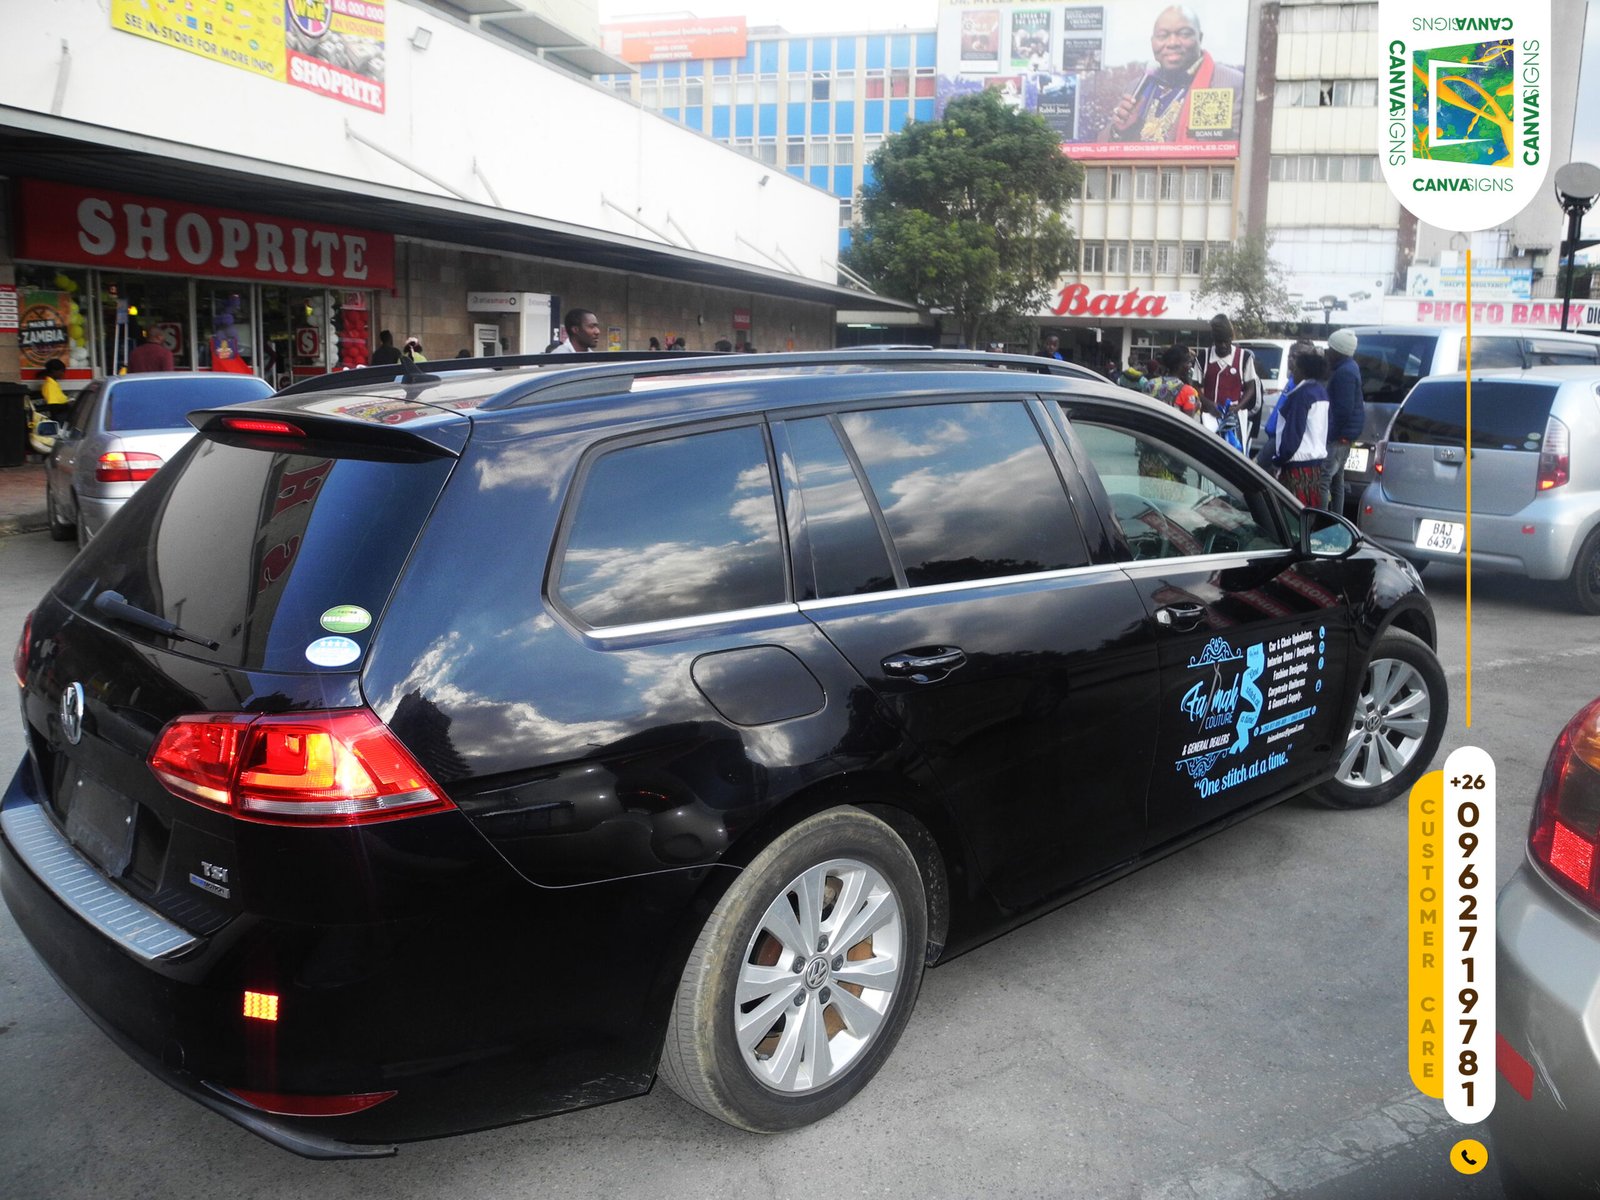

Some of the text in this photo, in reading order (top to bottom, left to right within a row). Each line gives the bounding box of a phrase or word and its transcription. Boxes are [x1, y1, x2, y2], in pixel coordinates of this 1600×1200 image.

[124, 12, 274, 74] SEE IN-STORE FOR MORE INFO
[290, 55, 383, 108] SHOPRITE
[77, 197, 368, 280] SHOPRITE
[1050, 282, 1168, 317] Bata
[1417, 301, 1504, 324] PHOTO
[1512, 303, 1585, 326] BANK
[21, 329, 65, 344] ZAMBIA
[1433, 522, 1453, 536] BAJ
[1427, 535, 1452, 549] 6439
[1204, 712, 1233, 730] COUTURE
[1187, 738, 1209, 754] GENERAL
[1209, 733, 1231, 749] DEALERS
[1221, 764, 1248, 790] stitch
[1249, 759, 1259, 779] at
[1260, 763, 1267, 774] a
[201, 861, 228, 883] TSI
